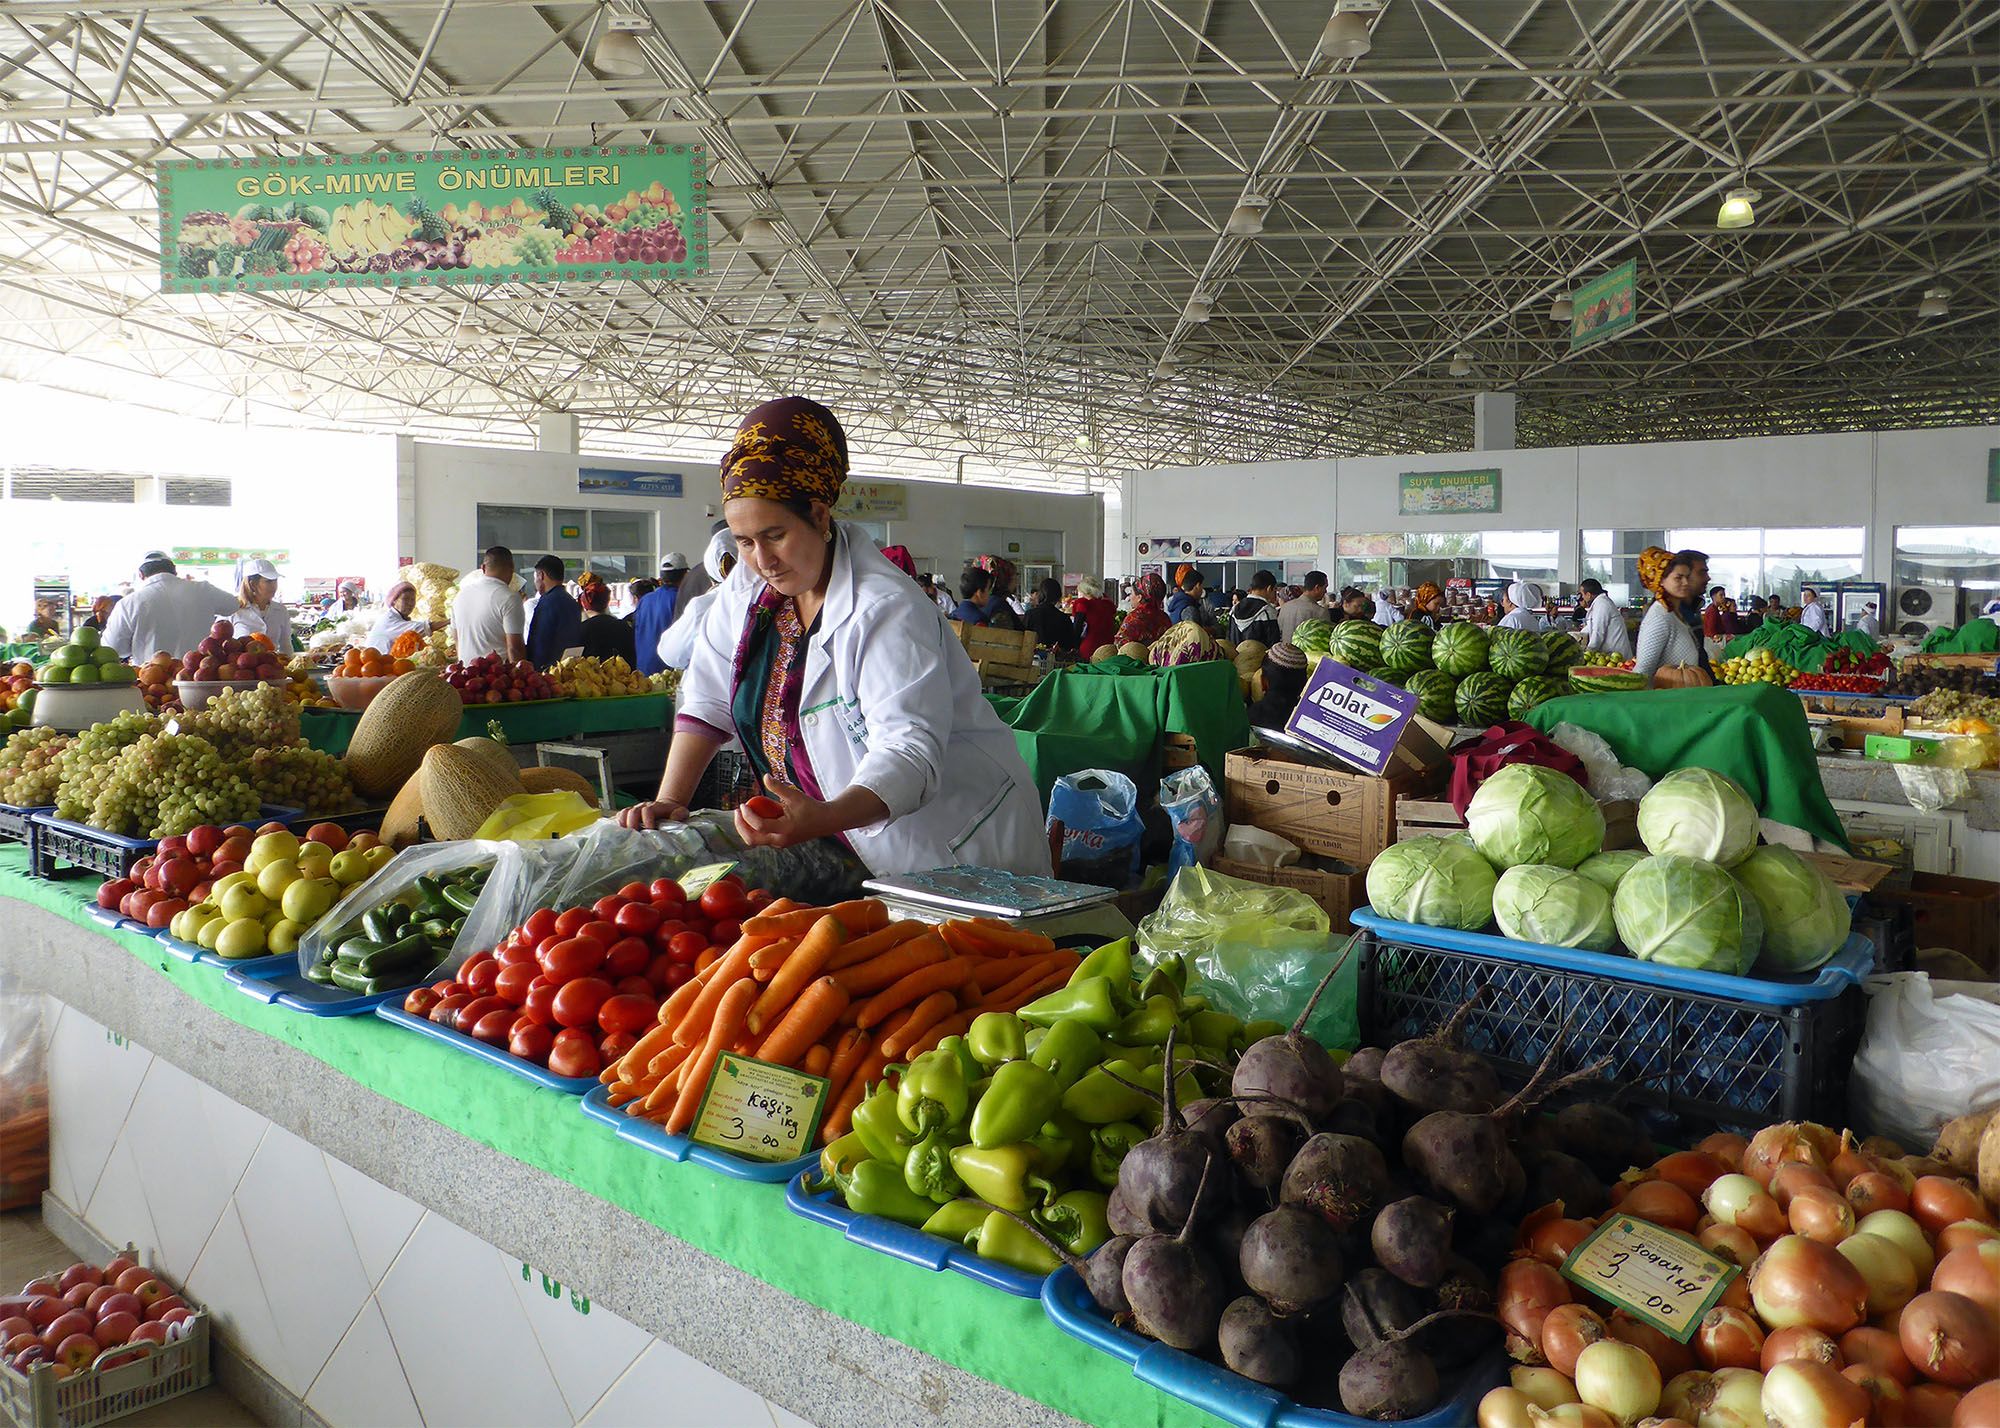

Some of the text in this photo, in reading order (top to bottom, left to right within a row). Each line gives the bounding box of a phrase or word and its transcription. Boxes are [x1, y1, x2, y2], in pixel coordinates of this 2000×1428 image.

[235, 164, 621, 198] GÖK-MIWE ÖNÜMLERI
[1316, 686, 1371, 718] polat
[1260, 769, 1348, 788] PREMIUM BANANAS
[719, 1117, 744, 1140] 3
[761, 1133, 779, 1148] 00
[1597, 1252, 1673, 1314] 3 00
